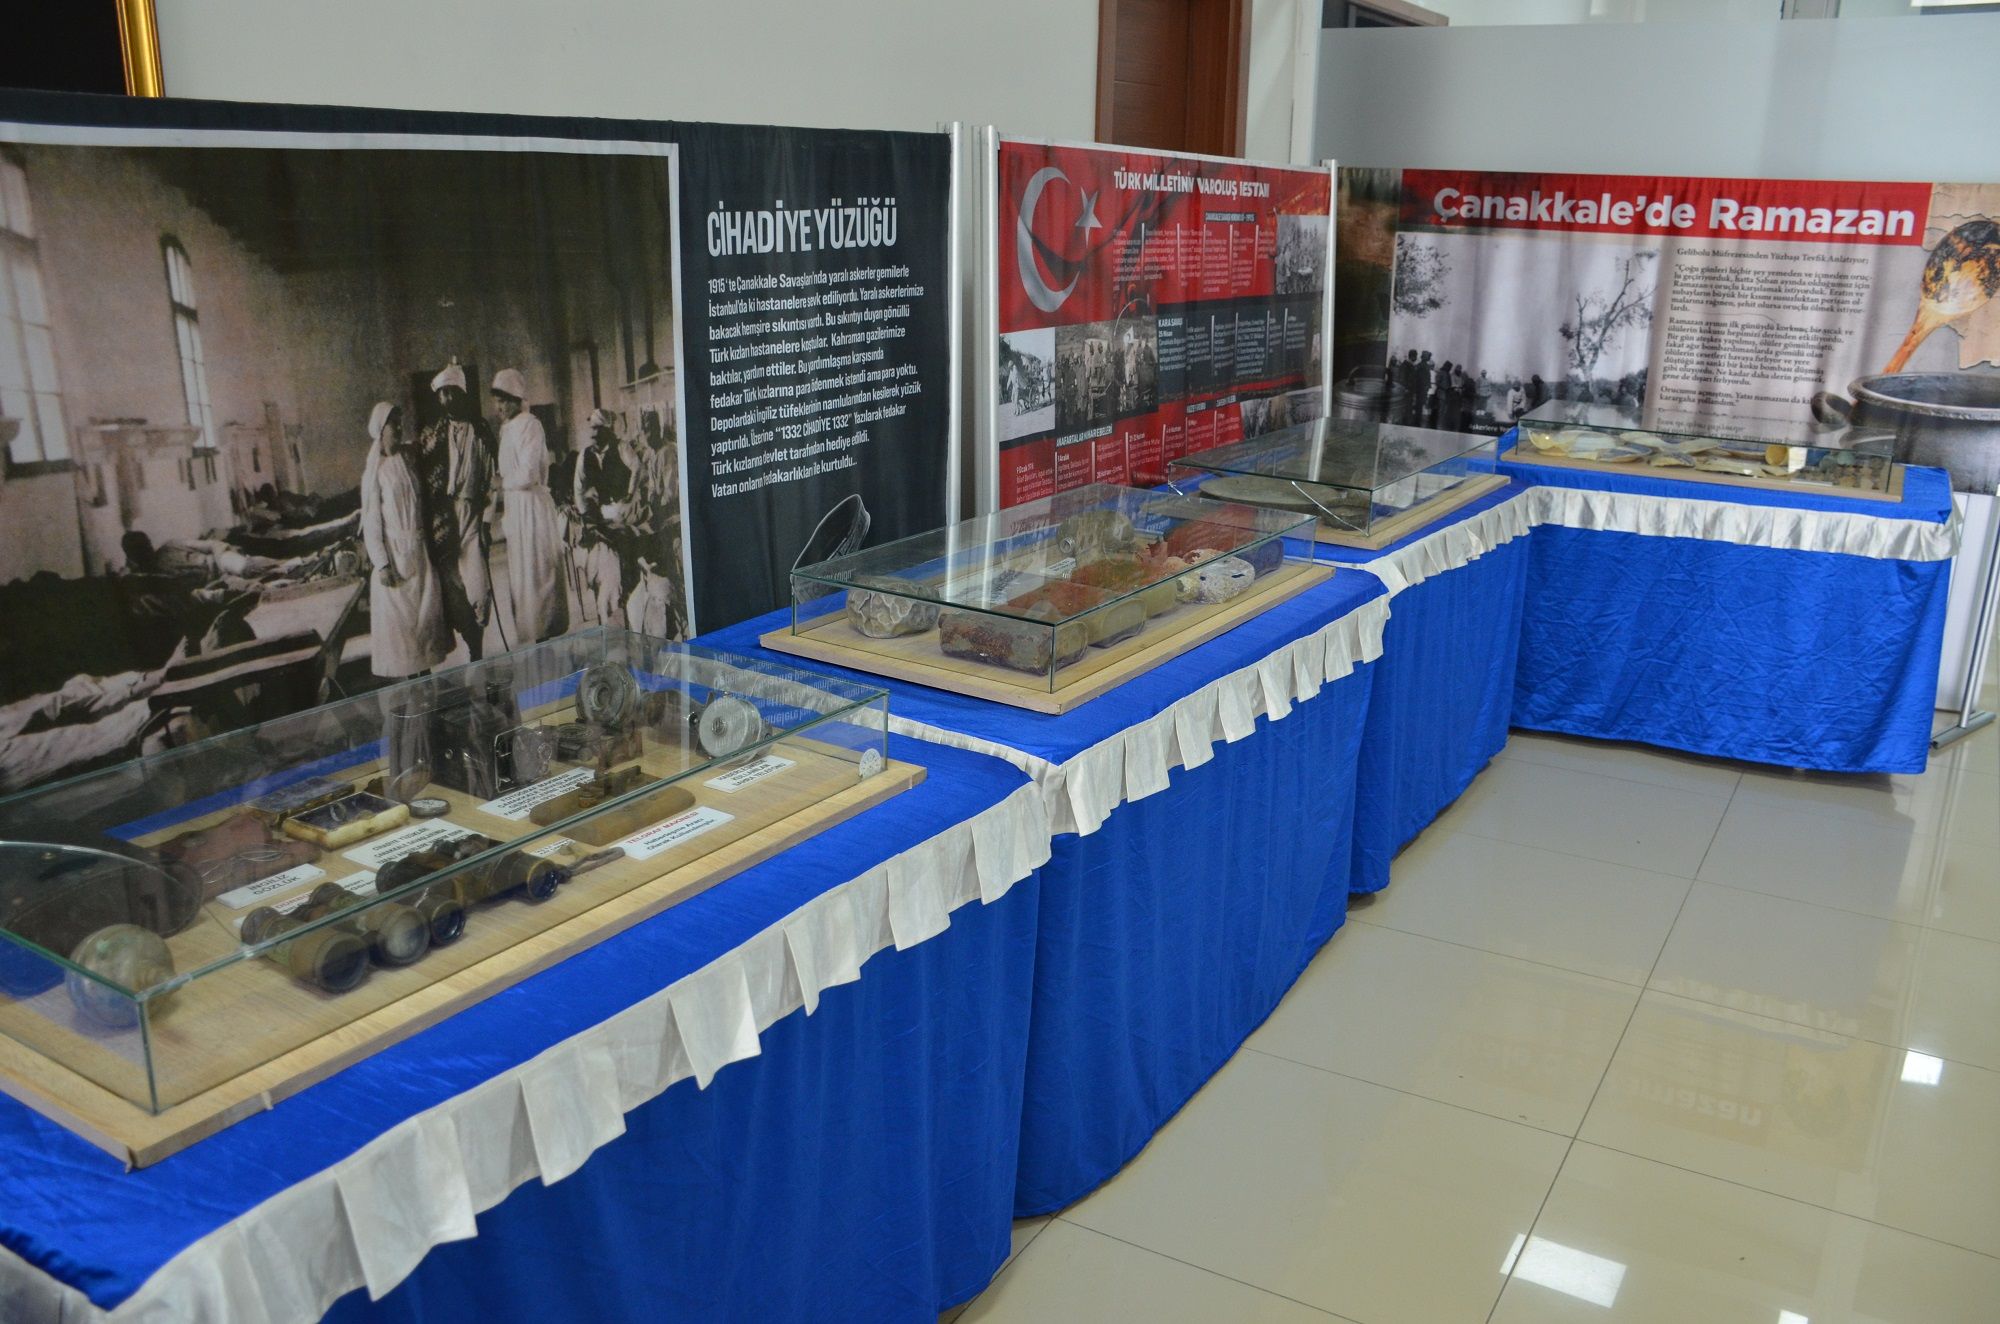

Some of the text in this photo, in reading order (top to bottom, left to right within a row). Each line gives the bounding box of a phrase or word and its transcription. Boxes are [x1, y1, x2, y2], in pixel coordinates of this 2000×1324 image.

[1114, 167, 1142, 190] TÜRK
[1434, 188, 1914, 236] Çanakkale'de Ramazan
[707, 198, 897, 257] CİHADİYE YÜZÜĞÜ
[736, 275, 777, 294] Çanakkale
[757, 296, 806, 312] hastanelere
[710, 323, 740, 340] bakacak
[826, 313, 835, 326] Bu
[864, 309, 882, 323] duyan
[710, 347, 729, 362] Türk
[750, 340, 800, 357] hastanelere
[831, 333, 865, 346] Kahraman
[766, 361, 796, 377] ettiler.
[710, 392, 742, 408] fedakar
[743, 388, 757, 402] Türk
[882, 370, 894, 382] para
[896, 364, 917, 379] yoktu.
[712, 459, 732, 475] Türk
[763, 447, 787, 464] devlet
[826, 435, 850, 450] hediye
[712, 482, 737, 497] Vatan
